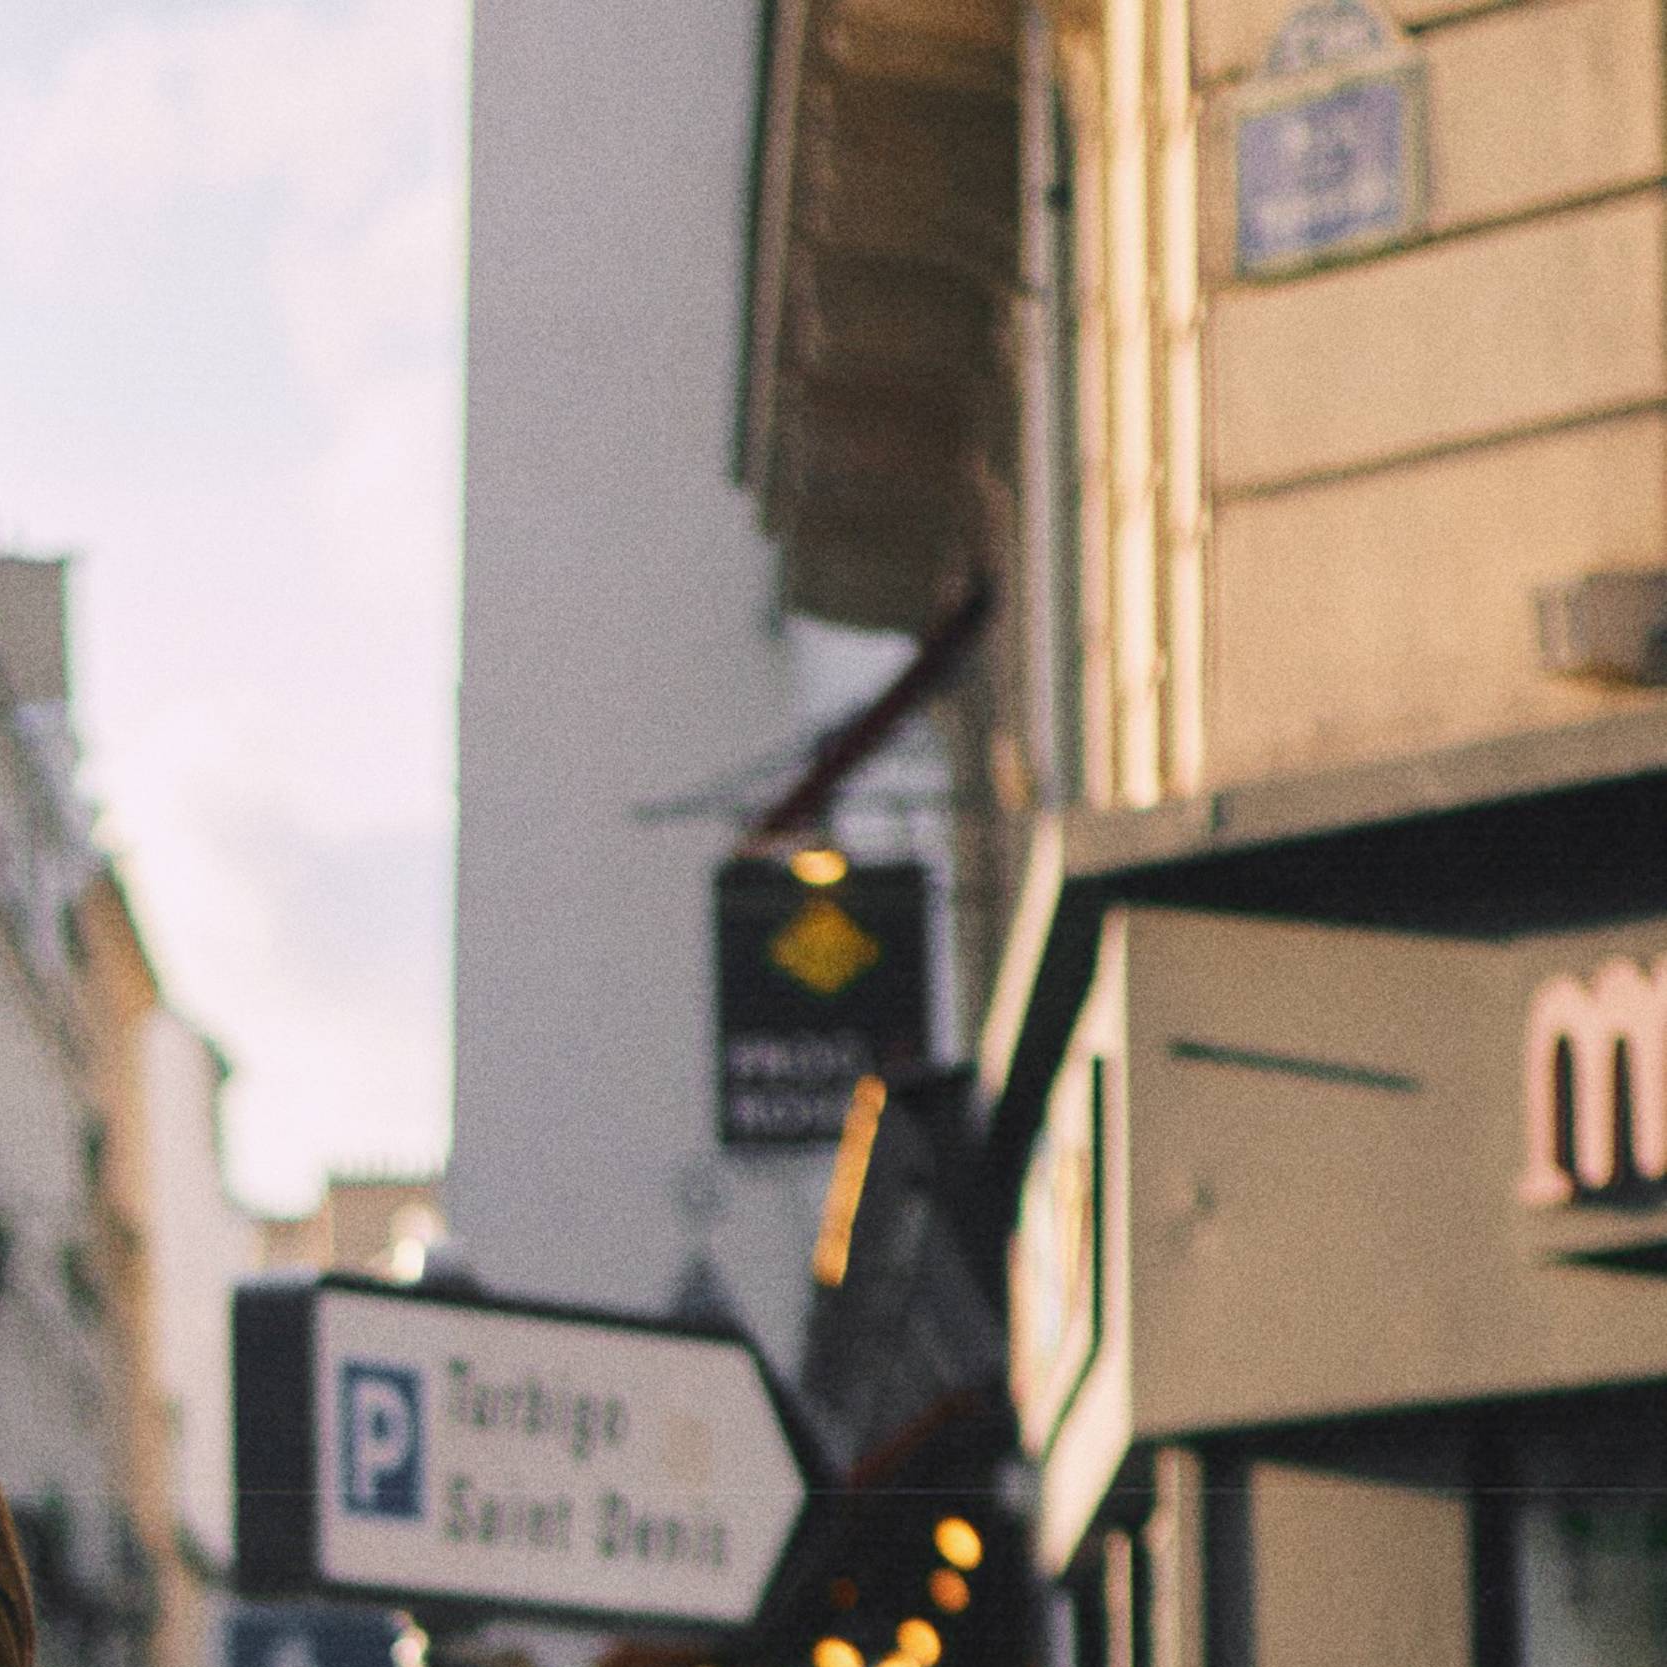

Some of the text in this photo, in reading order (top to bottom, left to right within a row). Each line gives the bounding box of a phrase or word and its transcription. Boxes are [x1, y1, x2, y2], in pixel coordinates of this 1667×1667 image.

[446, 1356, 630, 1462] Turbigo
[444, 1474, 731, 1568] Saint Denis
